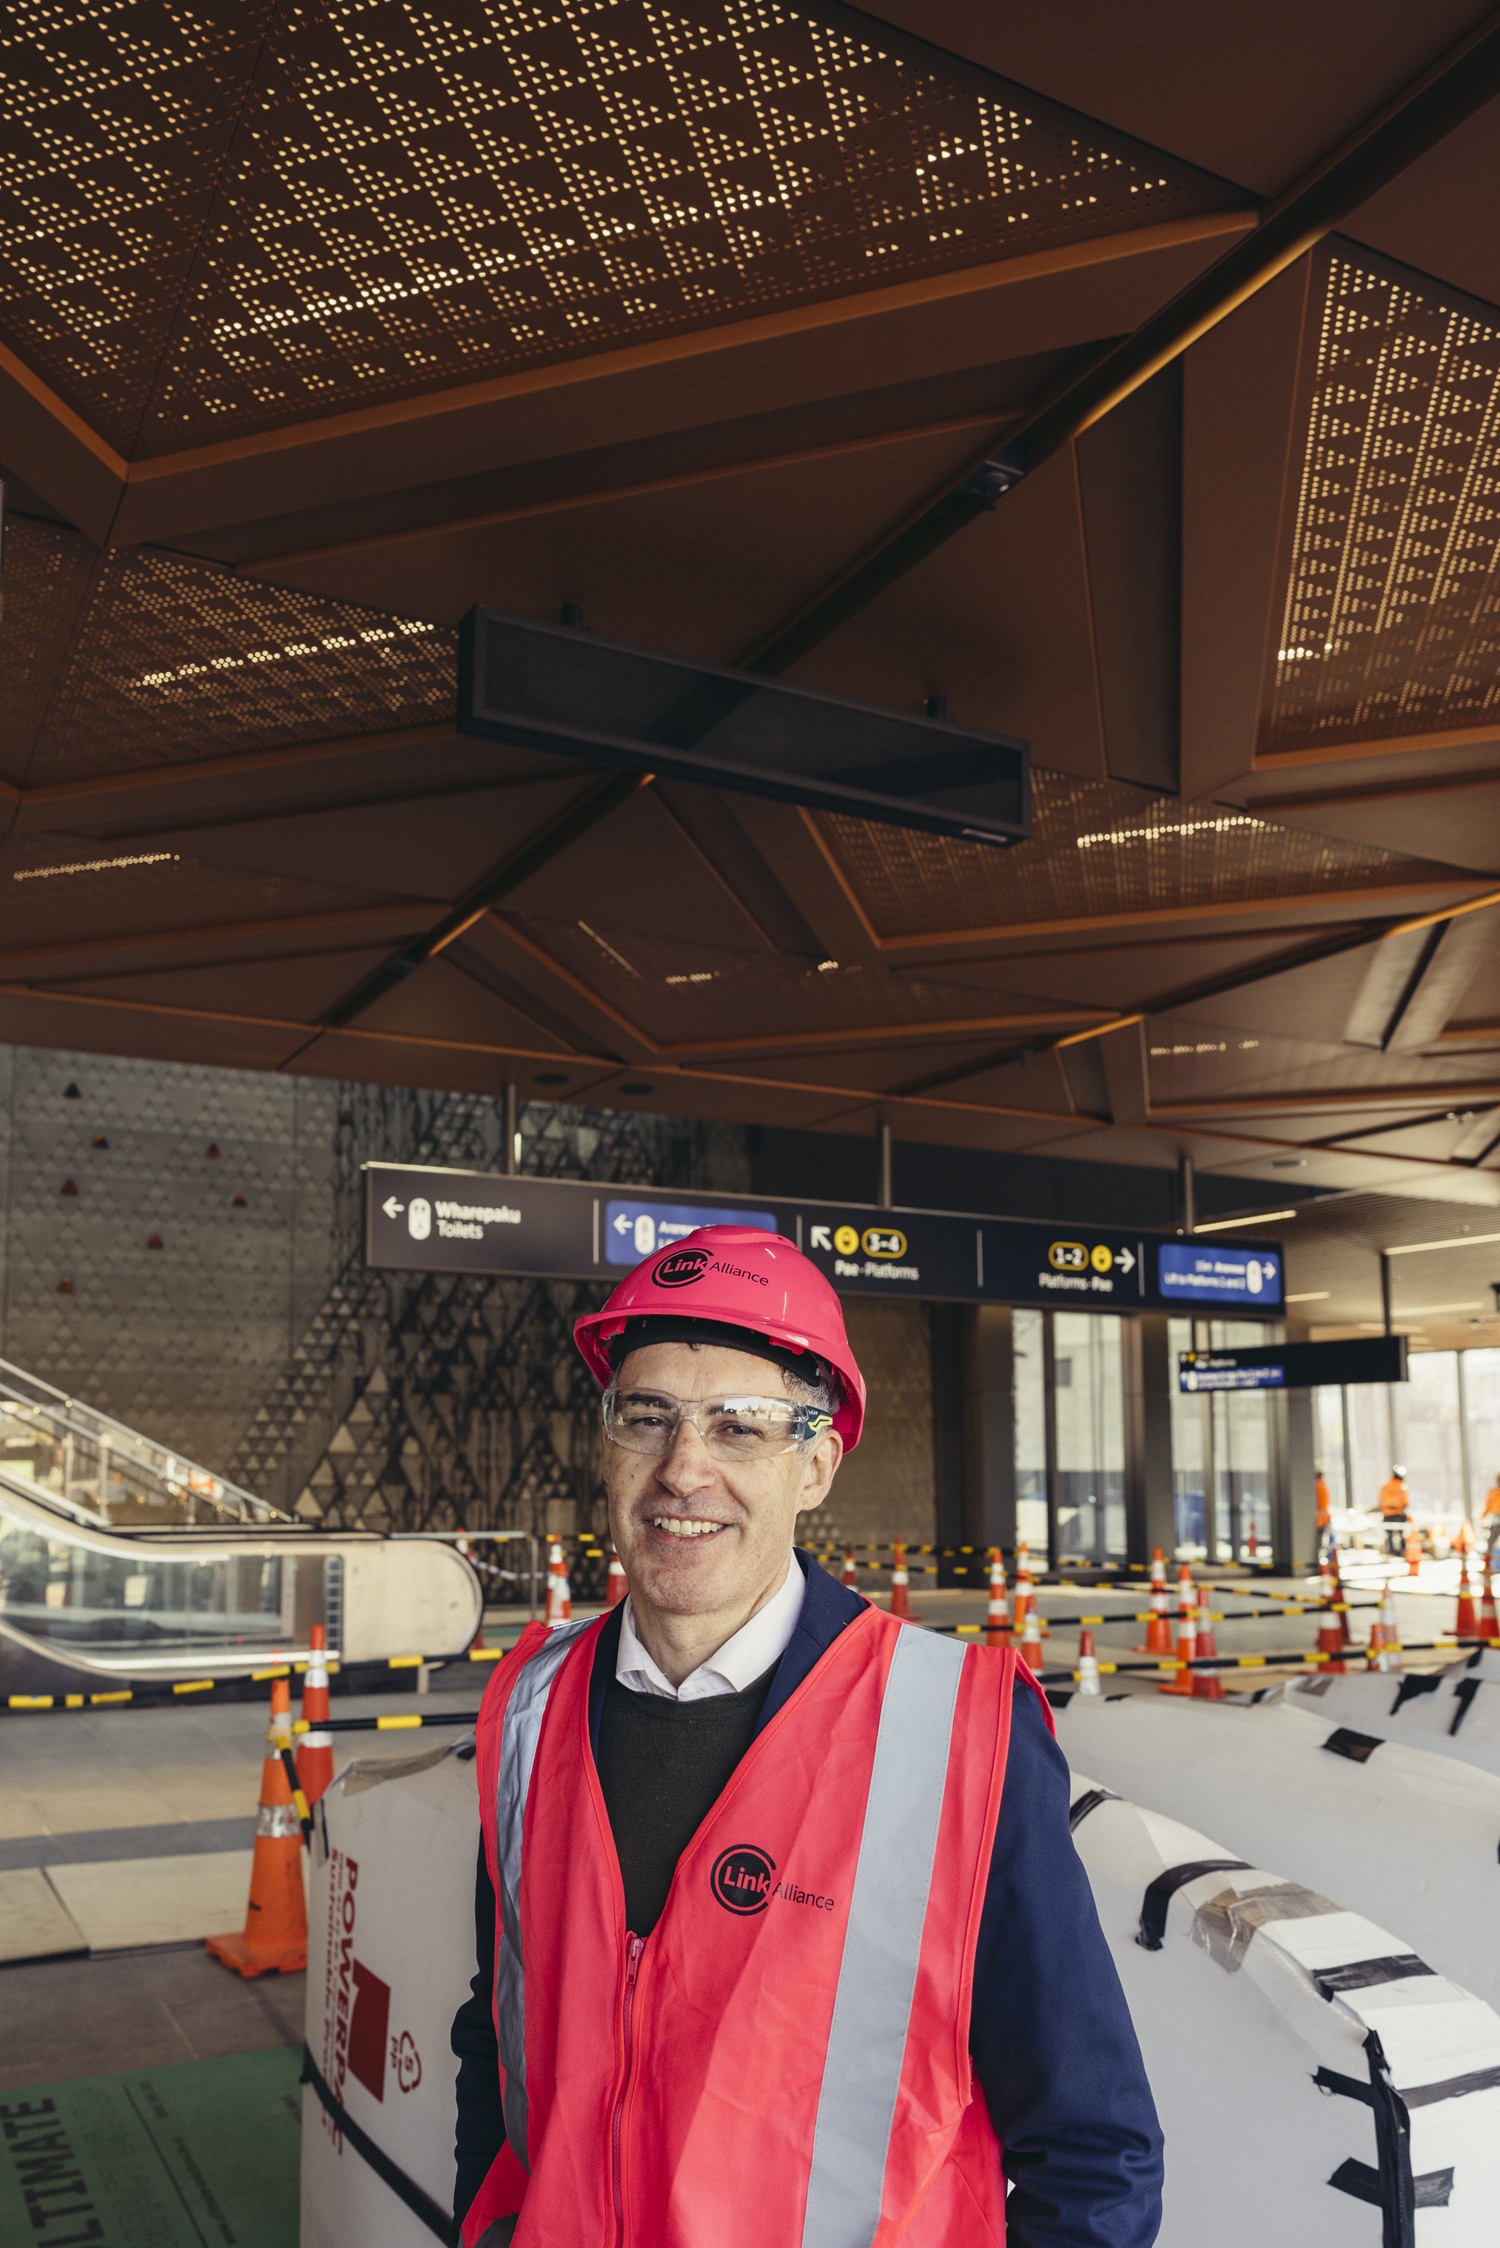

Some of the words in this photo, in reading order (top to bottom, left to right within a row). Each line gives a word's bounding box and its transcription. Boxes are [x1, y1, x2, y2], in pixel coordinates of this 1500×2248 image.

[434, 1200, 522, 1224] Wharepaku
[436, 1219, 484, 1240] Toilets
[662, 1257, 708, 1274] Link
[709, 1261, 769, 1286] Alliance
[834, 1259, 860, 1277] Pae
[864, 1261, 920, 1281] Platforms
[1038, 1272, 1088, 1291] Platforms
[1091, 1275, 1114, 1293] Pae
[723, 1865, 771, 1895] Link
[771, 1882, 835, 1911] Alliance
